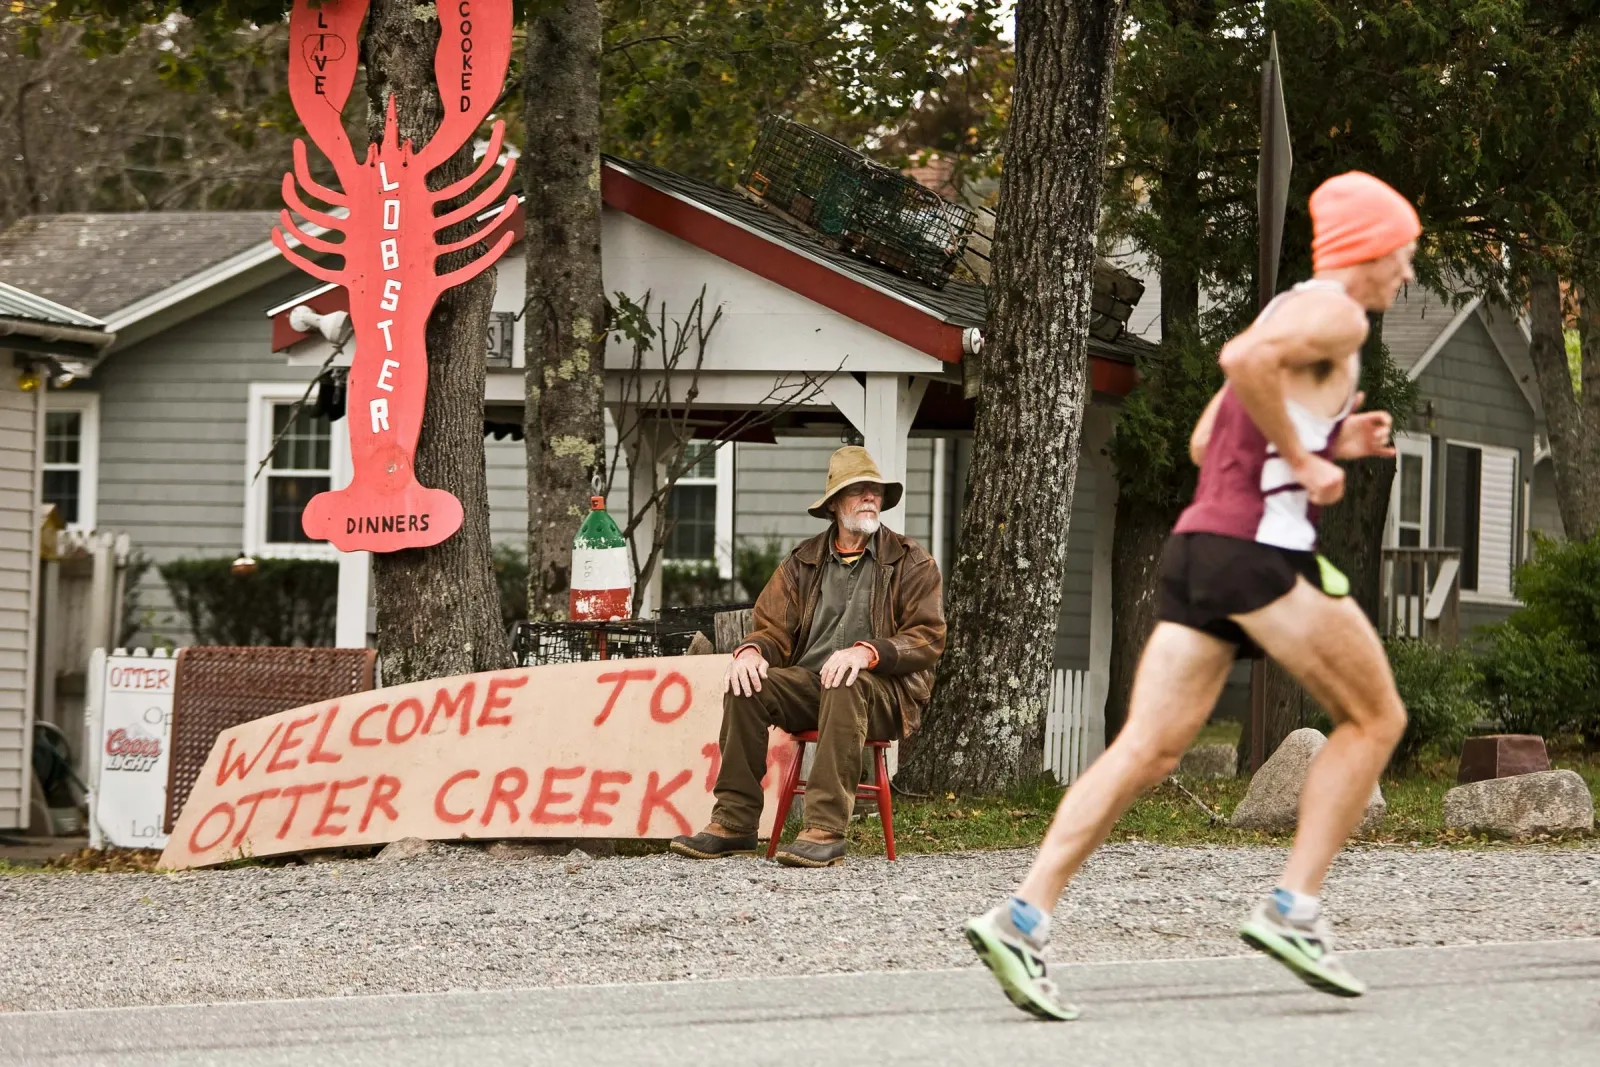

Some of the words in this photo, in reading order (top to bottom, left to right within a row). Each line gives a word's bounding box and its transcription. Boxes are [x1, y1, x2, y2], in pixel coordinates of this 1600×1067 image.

[315, 12, 328, 94] LIVE
[459, 1, 473, 113] COOKED
[369, 162, 402, 433] LOBSTER
[346, 514, 430, 534] DINNERS
[110, 667, 170, 689] OTTER
[105, 728, 162, 757] Coors
[105, 755, 159, 772] LIGHT
[215, 675, 529, 787] WELCOME
[593, 669, 693, 727] TO
[188, 774, 402, 854] OTTER
[434, 766, 693, 836] CREEK
